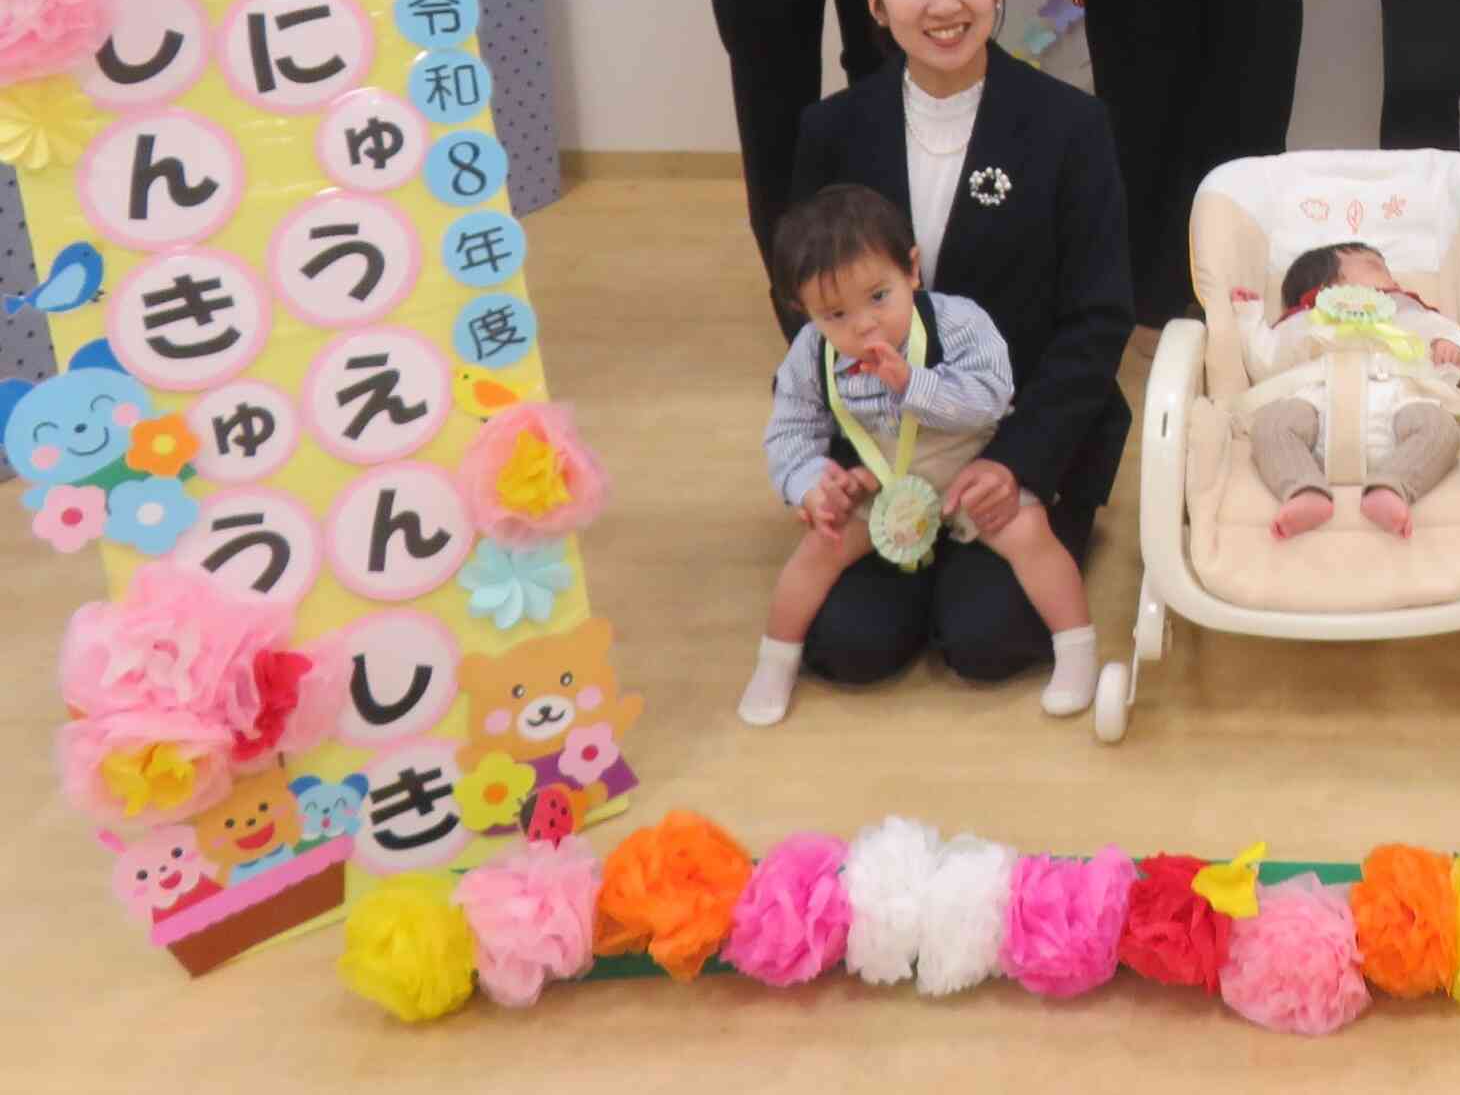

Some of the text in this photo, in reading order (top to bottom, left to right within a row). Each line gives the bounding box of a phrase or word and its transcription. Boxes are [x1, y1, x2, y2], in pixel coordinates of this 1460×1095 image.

[247, 4, 460, 852] にゅうえんしき
